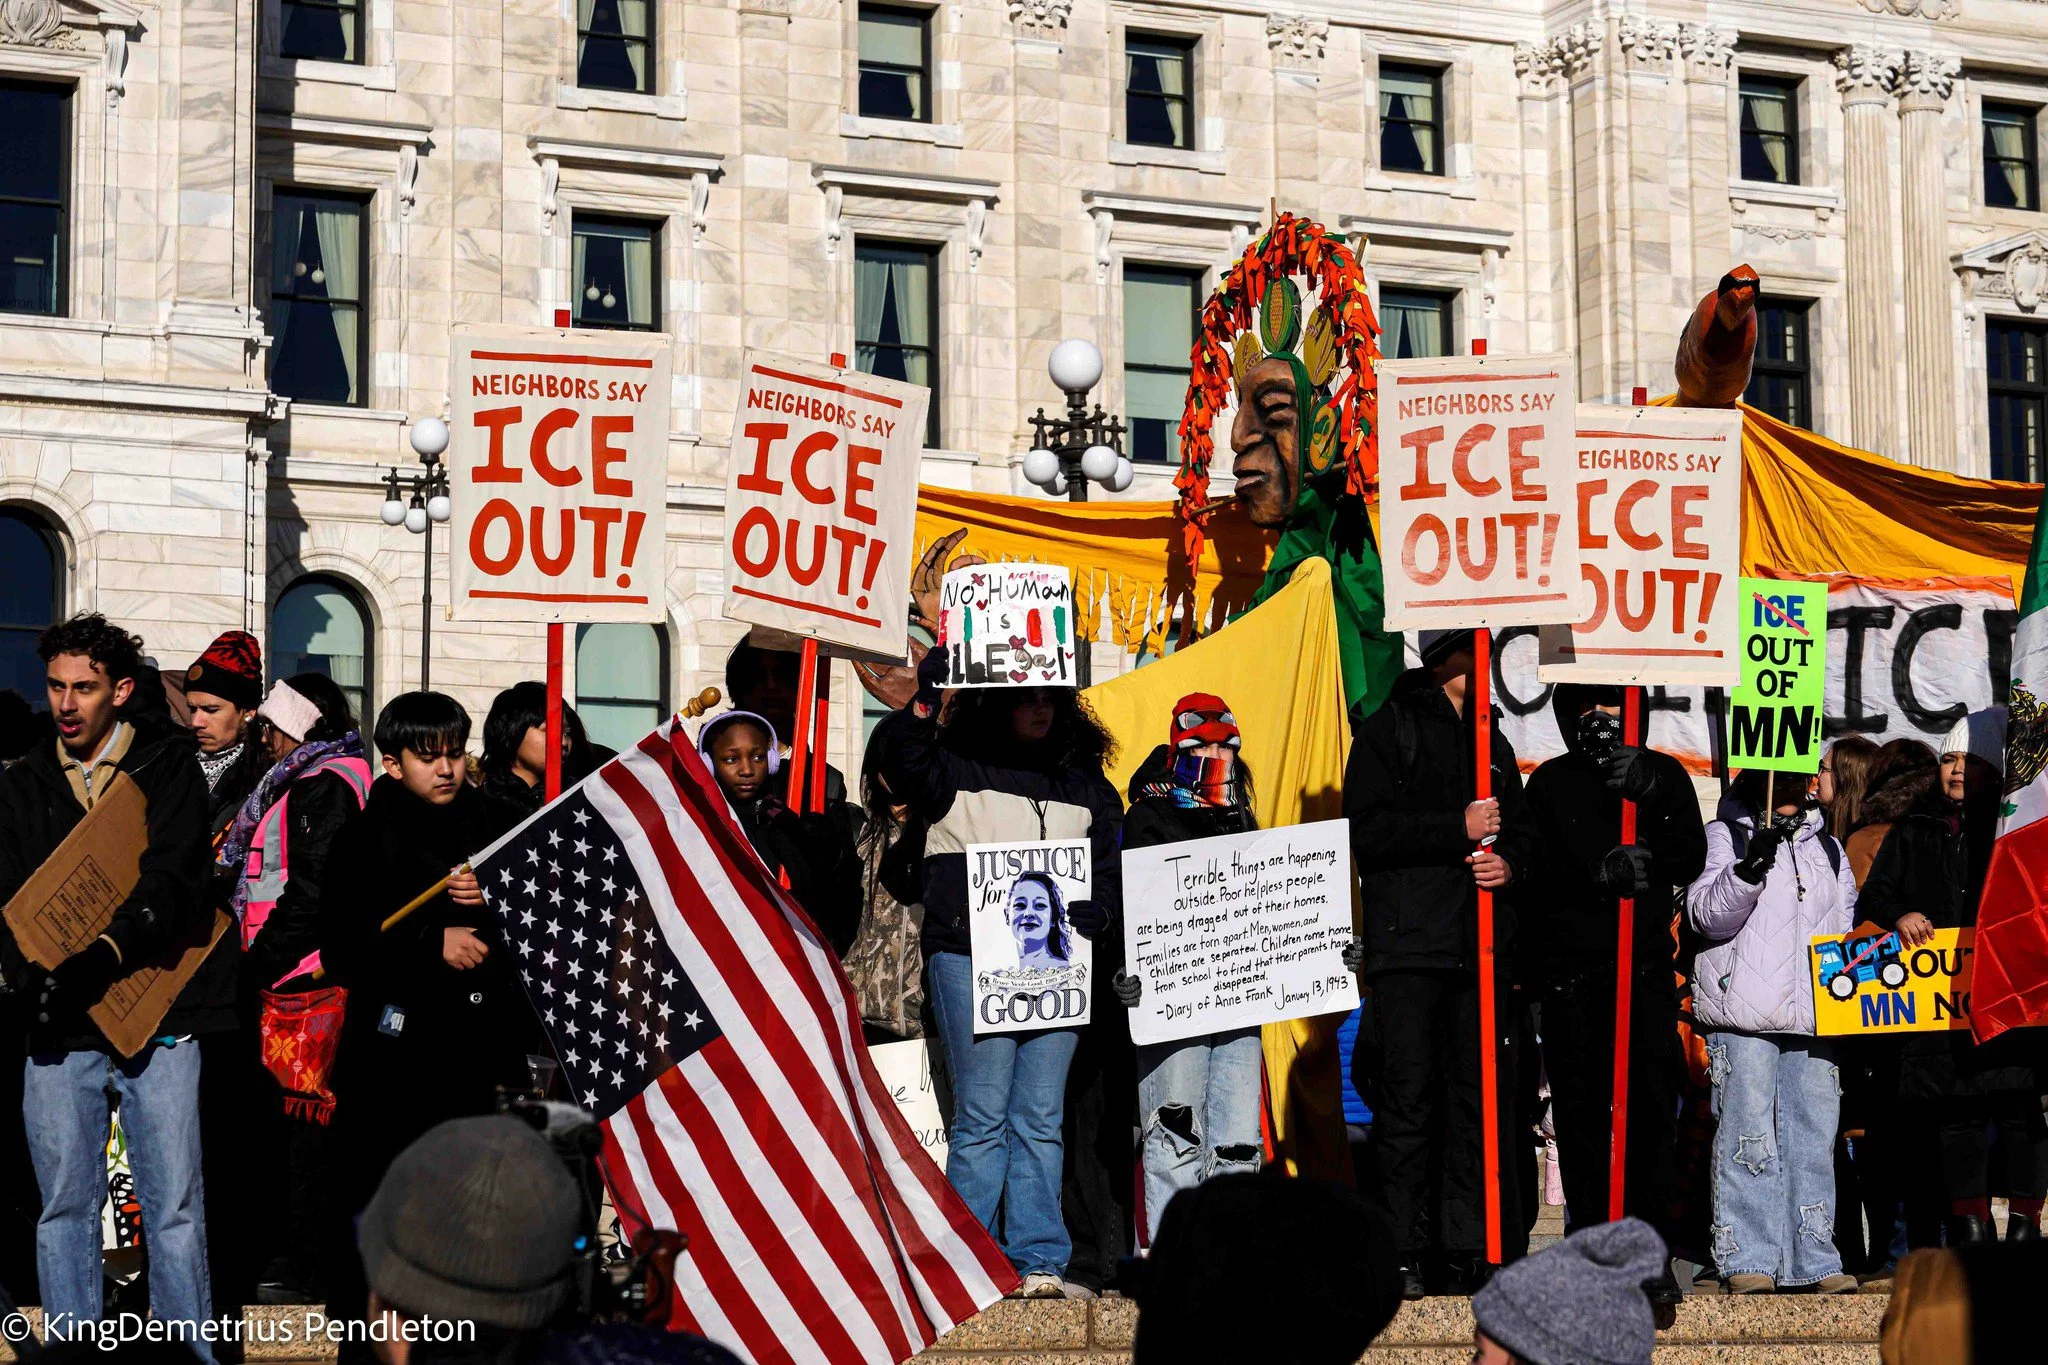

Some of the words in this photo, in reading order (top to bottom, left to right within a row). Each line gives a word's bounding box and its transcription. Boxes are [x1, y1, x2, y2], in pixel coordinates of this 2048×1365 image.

[472, 374, 599, 400] NEIGHBORS
[607, 381, 647, 403] SAY
[1399, 394, 1514, 420] NEIGHBORS
[1520, 392, 1555, 412] SAY
[748, 389, 856, 429] NEIGHBORS
[861, 415, 896, 439] SAY
[471, 406, 634, 497] ICE
[1400, 423, 1547, 501] ICE
[1578, 449, 1678, 471] EIGHBORS
[1685, 454, 1721, 472] SAY
[737, 422, 882, 526] ICE
[1577, 479, 1709, 560] ICE
[469, 498, 646, 589] OUT!
[733, 506, 887, 610] OUT!
[1401, 512, 1560, 588] OUT!
[1754, 595, 1805, 627] ICE
[1747, 634, 1813, 666] OUT
[1756, 669, 1798, 698] OF
[1731, 706, 1820, 758] MN!
[973, 847, 1086, 888] JUSTICE
[1165, 855, 1227, 892] Terrible
[1231, 850, 1265, 884] things
[1268, 856, 1284, 867] are
[1288, 843, 1336, 867] happening
[977, 880, 1006, 912] for
[1174, 890, 1219, 911] outside.
[1219, 885, 1242, 903] Poor
[1244, 880, 1283, 900] helpless
[1286, 871, 1325, 894] people
[1137, 924, 1152, 936] are
[1155, 918, 1183, 937] being
[1188, 908, 1228, 933] dragged
[1234, 907, 1249, 919] out
[1252, 903, 1263, 914] of
[1265, 898, 1291, 913] their
[1293, 893, 1329, 907] homes.
[1137, 941, 1181, 971] Families
[1184, 942, 1197, 953] are
[1199, 937, 1220, 950] torn
[1223, 929, 1249, 949] apart.
[1154, 981, 1176, 994] from
[1182, 966, 1211, 987] school
[1216, 966, 1228, 977] to
[1231, 961, 1252, 976] find
[1255, 955, 1273, 971] that
[1275, 949, 1296, 967] their
[1298, 942, 1328, 962] parents
[1330, 939, 1350, 950] have
[1191, 956, 1205, 967] are
[1211, 942, 1258, 964] separated.
[1261, 935, 1301, 953] Children
[1304, 930, 1325, 942] come
[1328, 925, 1351, 937] home
[1198, 999, 1210, 1010] of
[1215, 994, 1242, 1008] Anne
[1275, 984, 1310, 1011] January
[1326, 976, 1349, 993] 1943
[1214, 971, 1268, 992] disappeared.
[981, 988, 1087, 1025] GOOD
[1860, 992, 1916, 1027] MN
